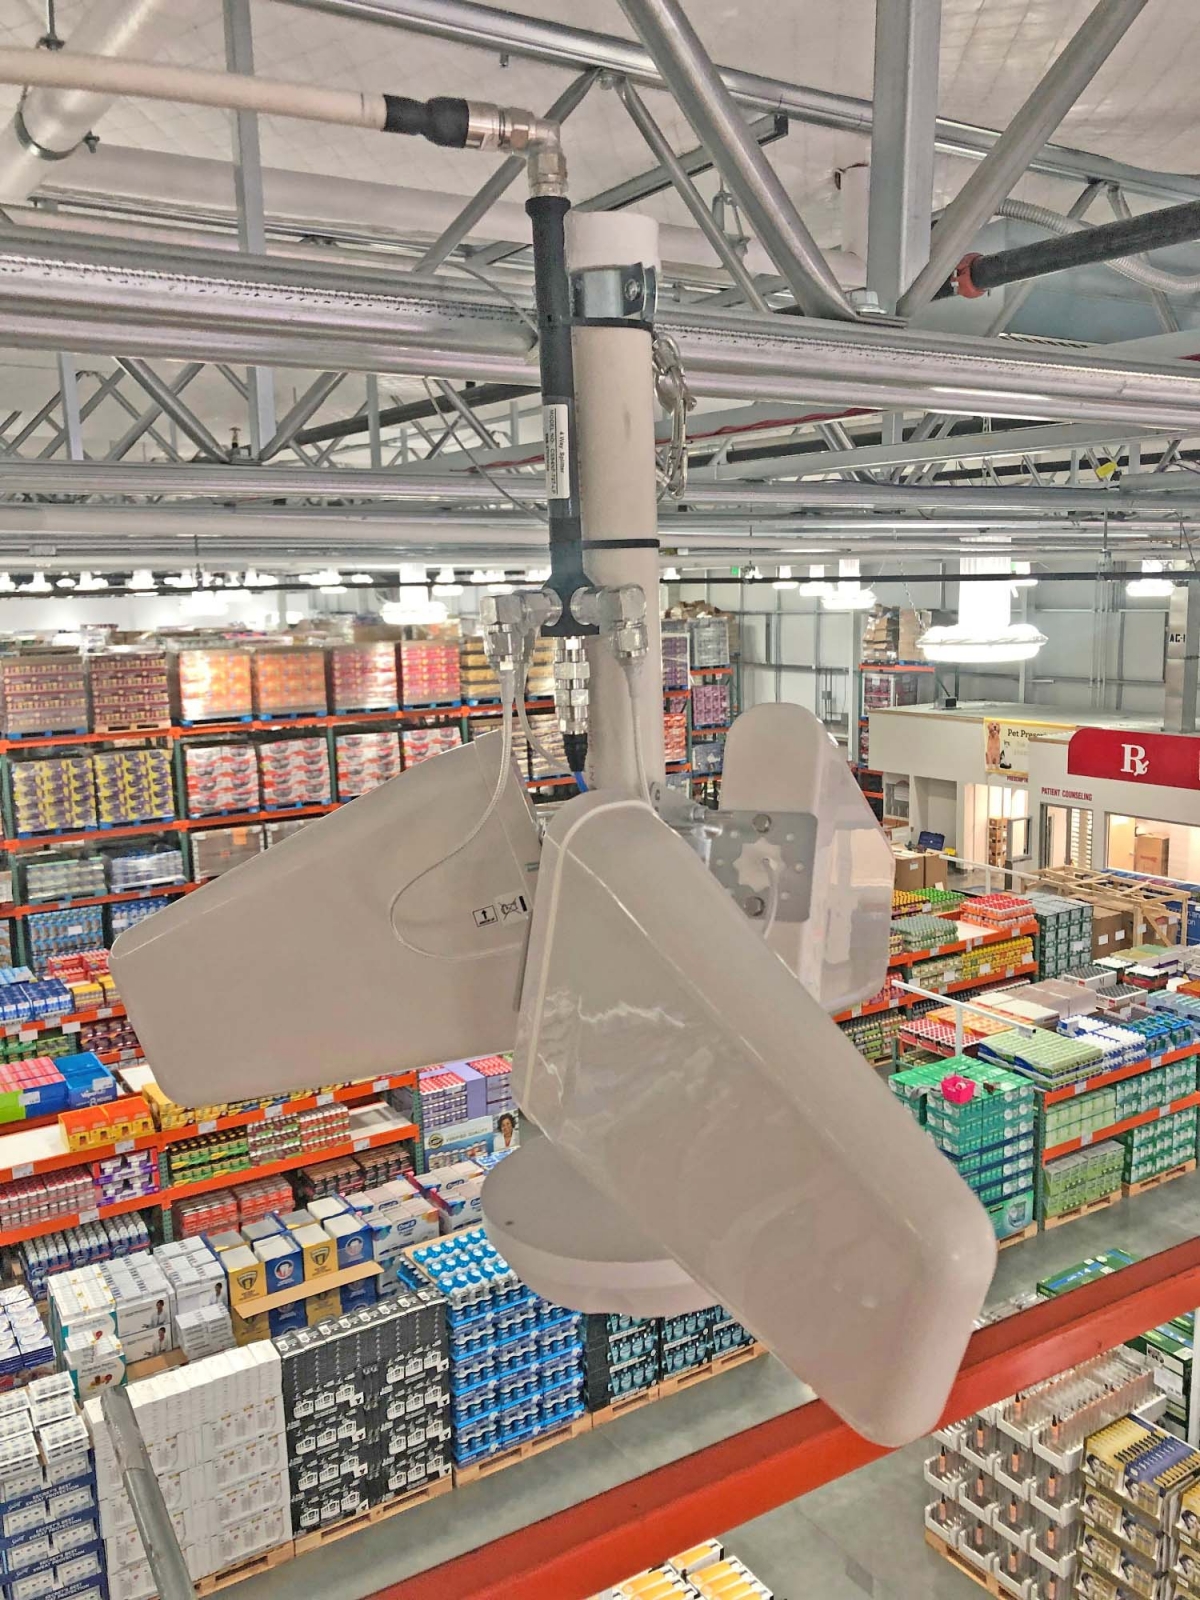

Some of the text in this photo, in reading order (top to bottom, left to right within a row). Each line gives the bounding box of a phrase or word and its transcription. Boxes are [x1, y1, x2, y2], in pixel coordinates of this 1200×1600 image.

[1007, 728, 1019, 737] Pet
[1041, 786, 1093, 801] PATIENT COUNSELING
[45, 1484, 80, 1499] PROTECTION
[58, 1482, 72, 1492] BEST
[48, 1517, 82, 1534] PROTECTION
[61, 1516, 75, 1525] BEST
[51, 1549, 85, 1565] PROTECTION
[64, 1548, 78, 1557] BEST
[69, 1582, 82, 1591] BEST
